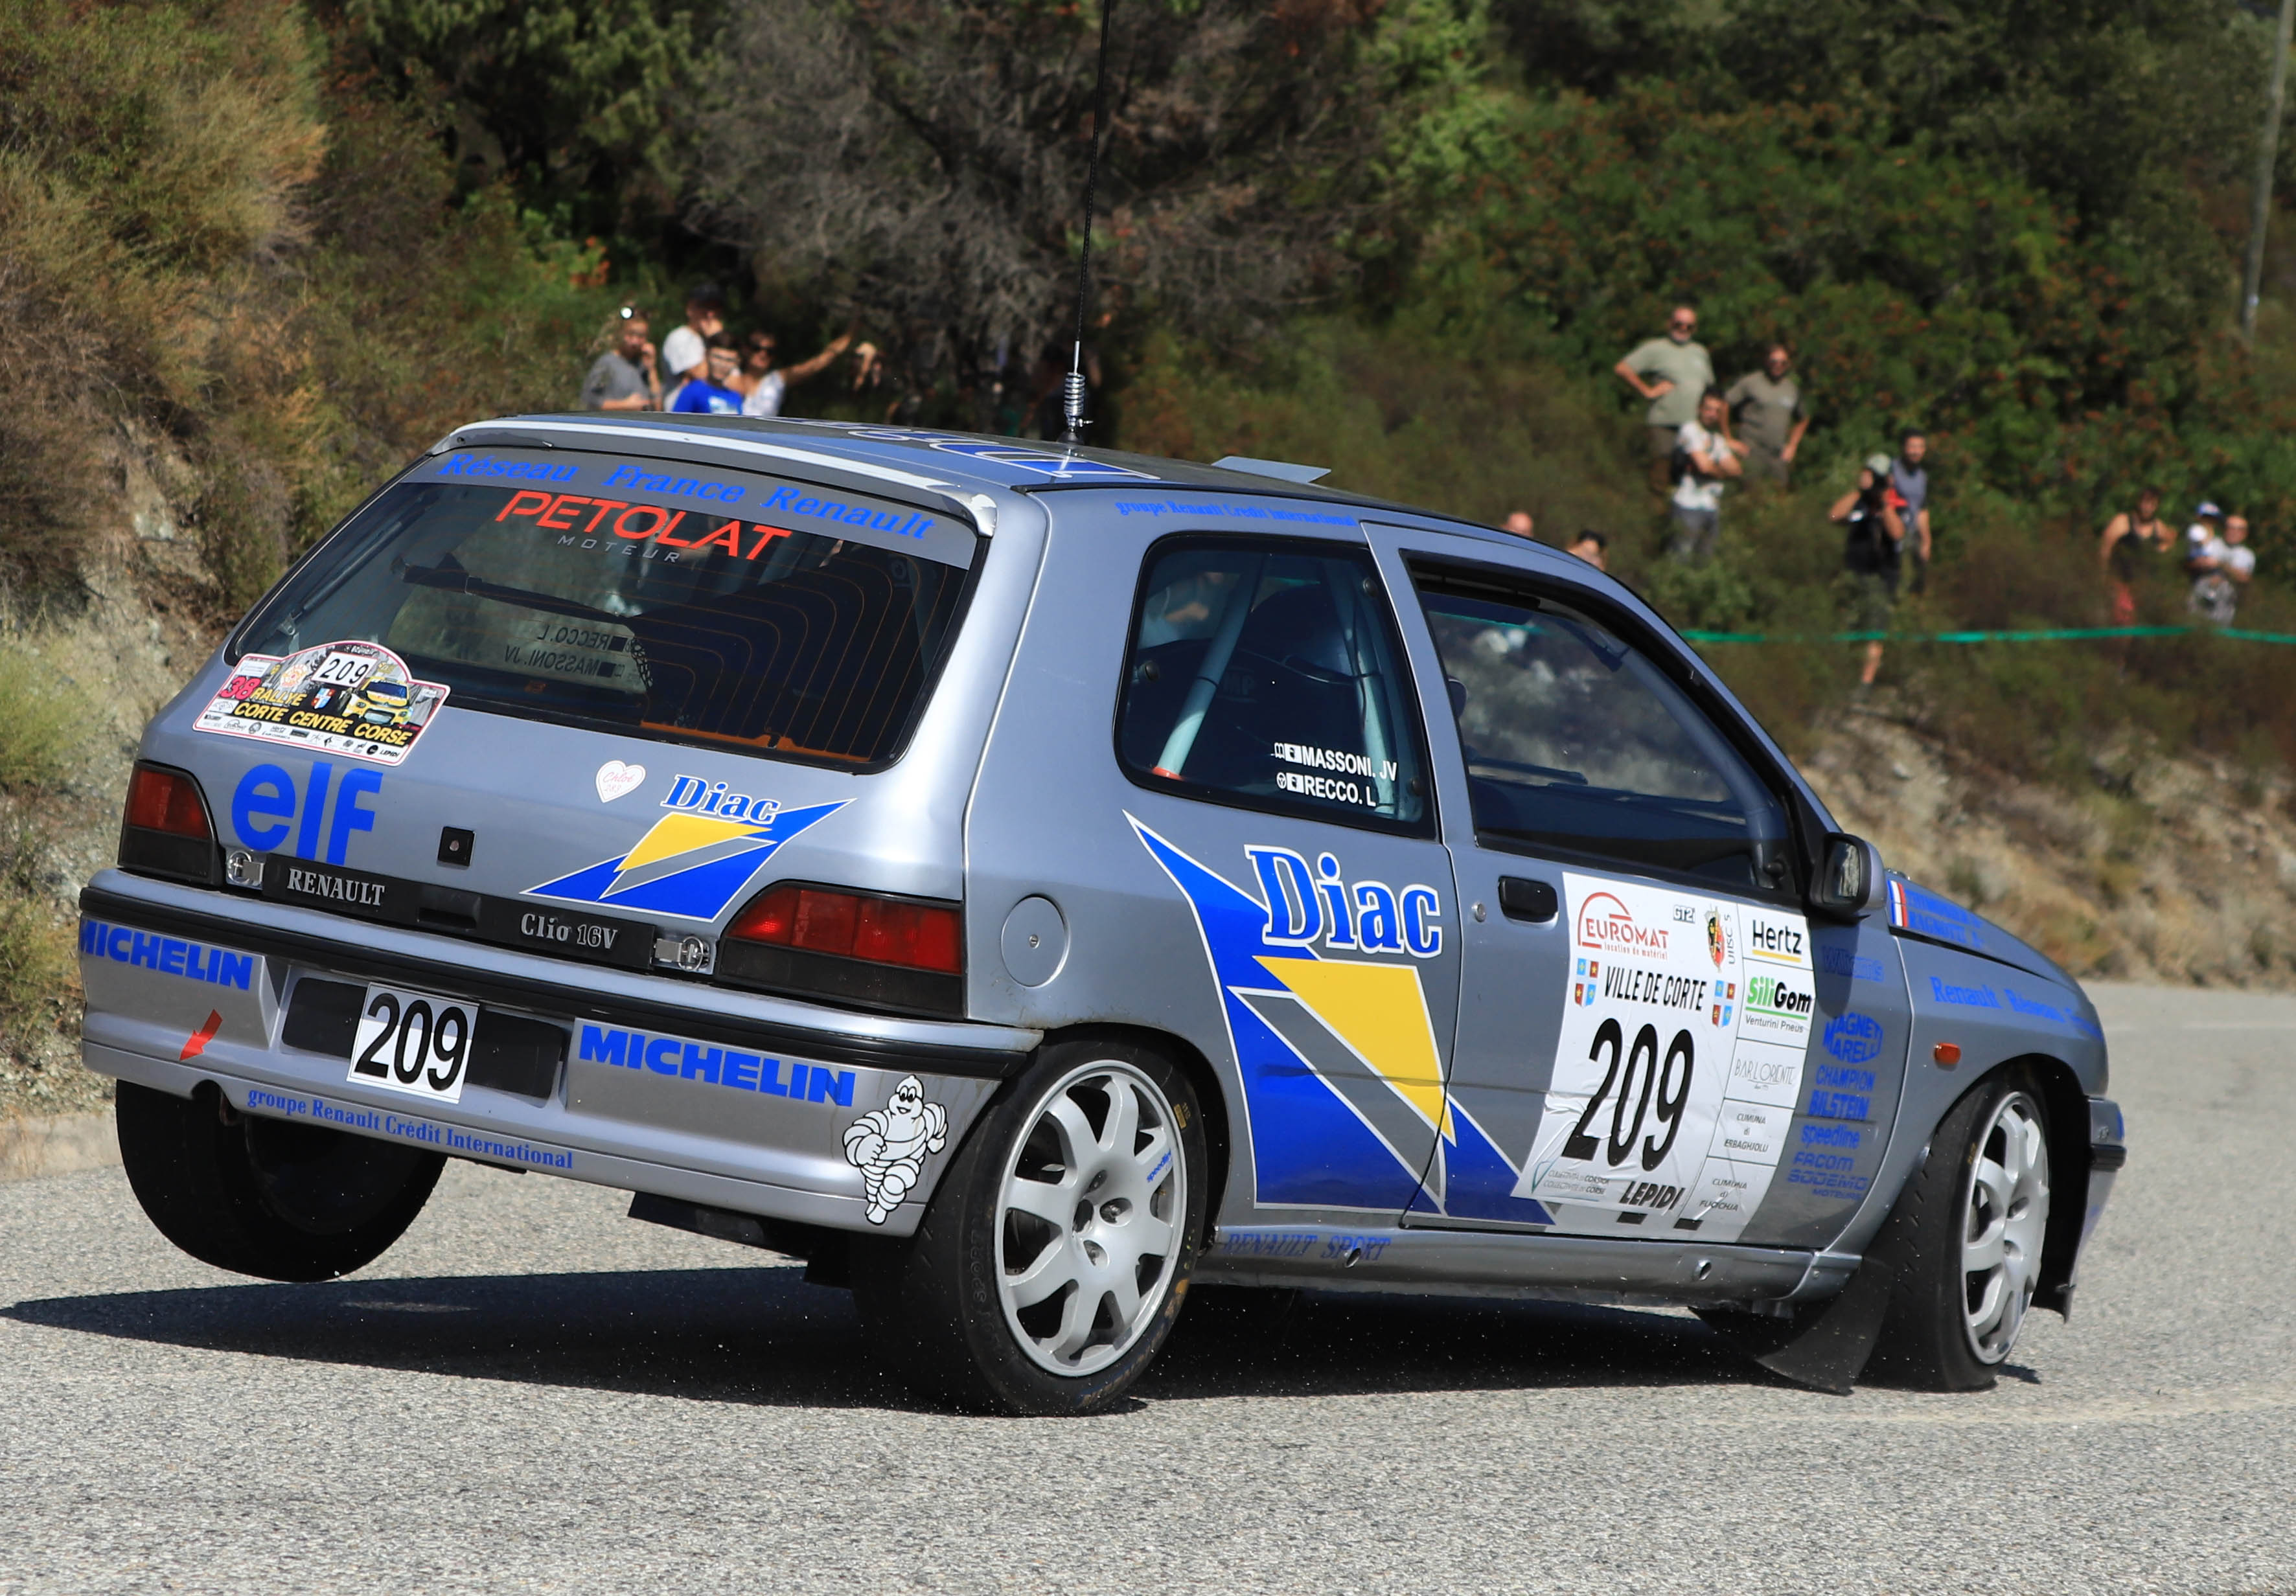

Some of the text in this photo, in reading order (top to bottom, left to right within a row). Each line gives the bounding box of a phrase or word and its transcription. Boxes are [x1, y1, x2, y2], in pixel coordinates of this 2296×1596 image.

[437, 453, 938, 542] Réseau France Renault
[495, 490, 792, 562] PETOLAT
[557, 534, 682, 564] MOTEUR
[321, 658, 369, 684] 209
[220, 676, 261, 700] 38
[250, 687, 308, 707] RALLYE
[234, 702, 413, 746] CORTE CENTRE CORSE
[1379, 760, 1397, 781] JV
[660, 773, 781, 826] Diac
[1366, 786, 1376, 806] L
[231, 762, 384, 866] elf
[288, 869, 385, 906] RENAULT
[1244, 844, 1443, 959] Diac
[520, 913, 619, 950] Clio 16V
[1586, 918, 1669, 949] EUROMAT
[1752, 919, 1802, 955] Hertz
[1605, 966, 1707, 1011] VILLE DE CORTE
[1747, 976, 1812, 1013] SiliGom
[1929, 976, 2003, 1009] Renault
[1746, 1015, 1804, 1032] Venturini Pneus
[355, 992, 470, 1091] 209
[579, 1025, 856, 1107] MICHELIN
[1734, 1059, 1753, 1079] BAR
[1815, 1064, 1876, 1092] CHAMPION
[1561, 1018, 1695, 1172] 209
[1808, 1089, 1870, 1121] BILSTEIN
[247, 1087, 573, 1169] groupe Renault Crédit International
[1736, 1113, 1767, 1124] CUMUNA
[1801, 1124, 1861, 1149] speedline
[1794, 1151, 1854, 1172] FACOM
[1619, 1181, 1686, 1210] LEPIDI
[1224, 1233, 1392, 1261] RENAULT SPORT
